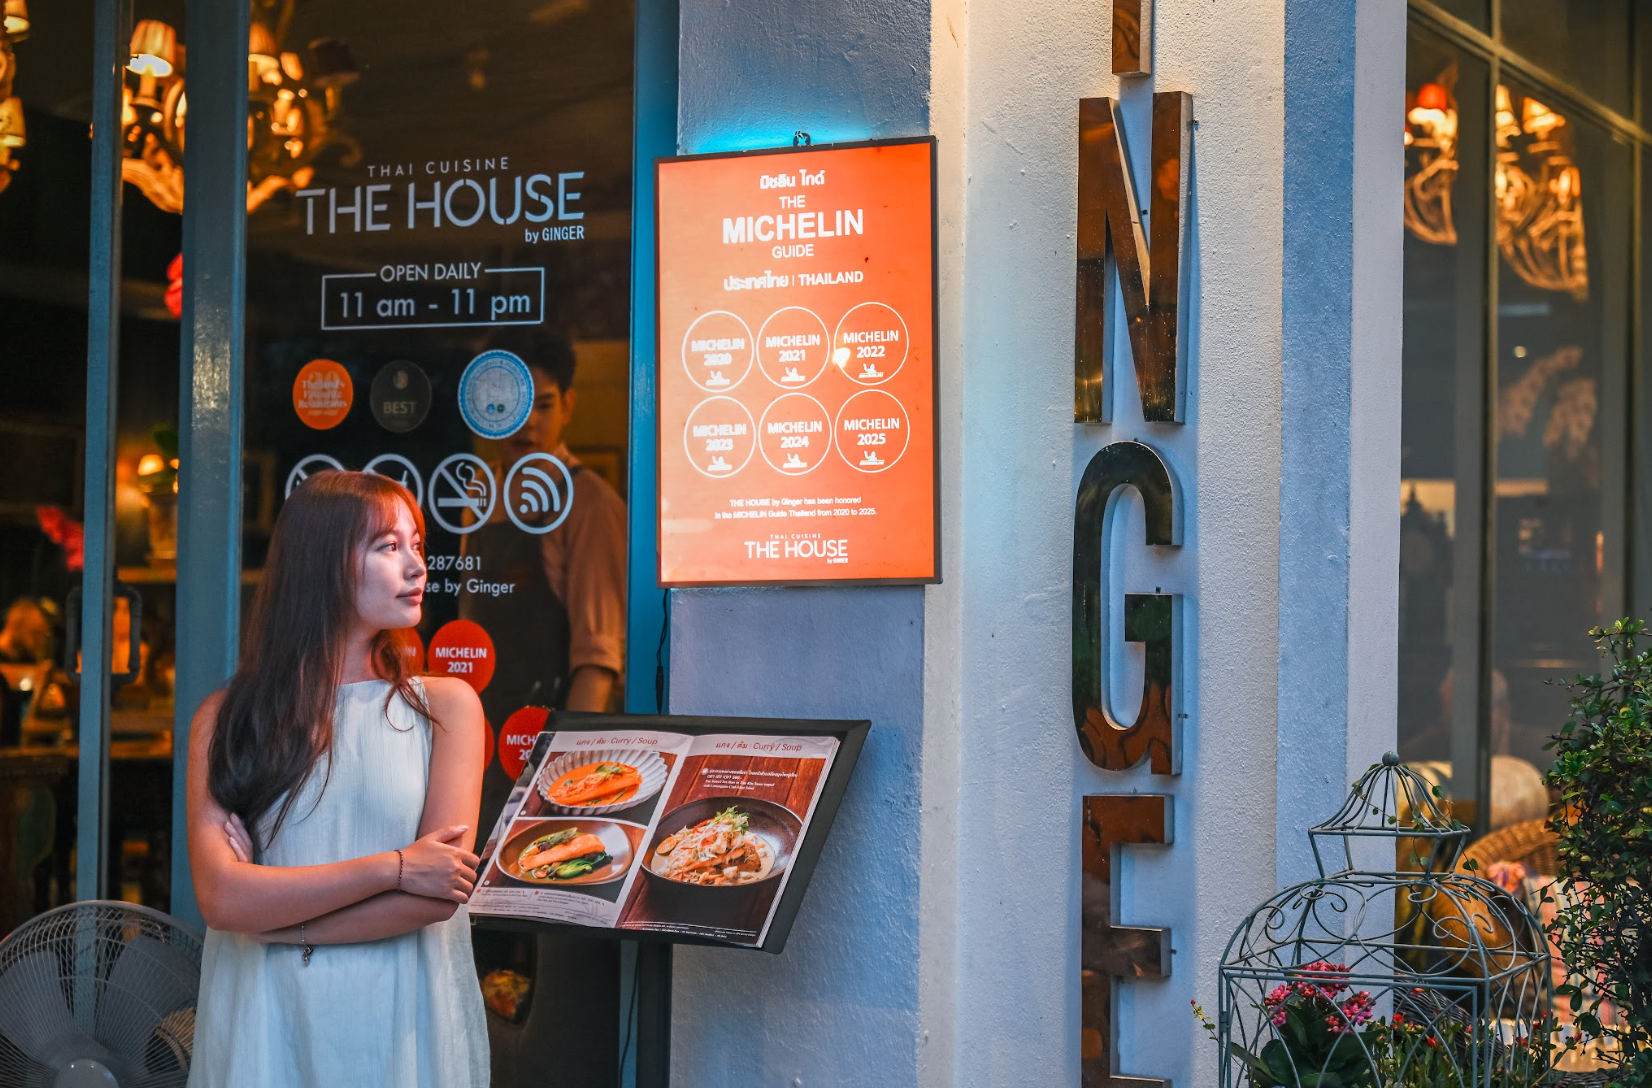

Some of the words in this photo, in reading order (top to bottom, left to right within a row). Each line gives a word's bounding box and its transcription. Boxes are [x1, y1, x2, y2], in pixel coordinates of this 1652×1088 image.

[368, 164, 413, 178] THAI
[426, 157, 509, 174] CUISINE
[295, 184, 391, 235] THE
[408, 171, 585, 229] HOUSE
[779, 195, 806, 209] THE
[722, 209, 864, 244] MICHELIN
[524, 228, 539, 244] by
[542, 225, 585, 241] GINGER
[772, 244, 814, 259] GUIDE
[379, 264, 428, 283] OPEN
[434, 262, 482, 281] DAILY
[798, 270, 864, 286] THAILAND
[340, 292, 362, 318] 11
[376, 297, 415, 318] am
[451, 288, 475, 315] 11
[491, 294, 531, 321] pm
[765, 334, 820, 348] MICHELIN
[843, 330, 899, 344] MICHELIN
[691, 338, 745, 352] MICHELIN
[856, 346, 885, 358] 2022
[778, 350, 806, 362] 2021
[383, 401, 417, 414] BEST
[693, 423, 747, 437] MICHELIN
[767, 421, 822, 434] MICHELIN
[844, 417, 900, 431] MICHELIN
[706, 438, 734, 451] 2023
[781, 436, 809, 448] 2024
[857, 433, 886, 445] 2025
[729, 499, 744, 507] THE
[745, 498, 771, 507] HOUSE
[772, 498, 780, 507] by
[781, 497, 802, 507] Ginger
[817, 497, 833, 505] been
[834, 496, 861, 505] honored
[733, 510, 767, 518] MICHELIN
[768, 510, 787, 518] Guide
[788, 509, 816, 517] Thailand
[817, 508, 832, 517] from
[833, 508, 849, 516] 2020
[850, 508, 857, 516] to
[744, 540, 780, 559] THE
[785, 539, 848, 558] HOUSE
[1072, 0, 1194, 1088] NGE
[444, 578, 461, 597] by
[466, 578, 514, 598] Ginger
[435, 647, 487, 659] MICHELIN
[447, 661, 473, 674] 2021
[506, 734, 537, 746] MICH
[610, 737, 631, 746] Curry
[637, 737, 658, 746] Soup
[753, 742, 775, 752] Curry
[781, 743, 803, 752] Soup
